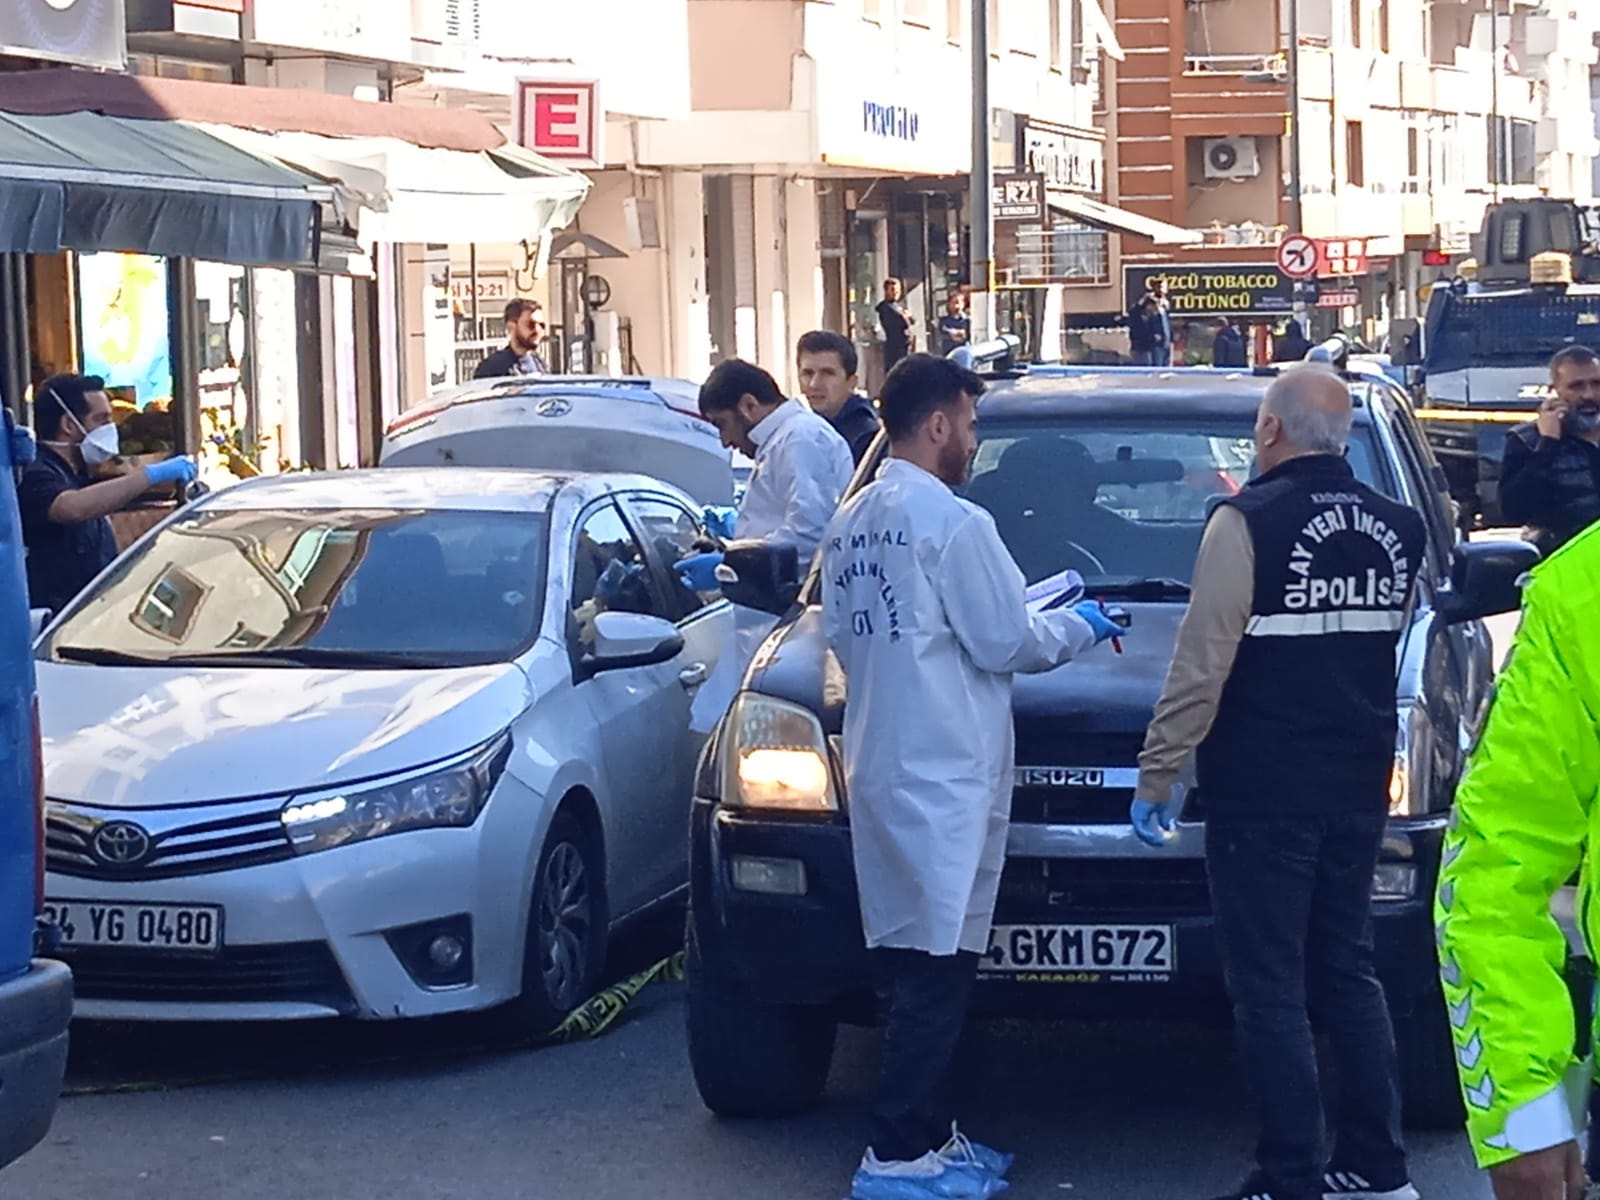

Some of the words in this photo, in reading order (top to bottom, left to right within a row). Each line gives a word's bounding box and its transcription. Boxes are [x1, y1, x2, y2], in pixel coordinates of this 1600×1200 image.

[535, 93, 579, 147] E
[1202, 274, 1278, 290] TOBACCO
[1171, 292, 1251, 310] TÜTÜNCÜ
[1284, 542, 1313, 608] OLAY
[1025, 769, 1101, 785] ISUZU
[90, 907, 124, 941] YG
[138, 909, 212, 944] 0480
[1010, 928, 1083, 966] GKM
[1092, 928, 1165, 966] 672
